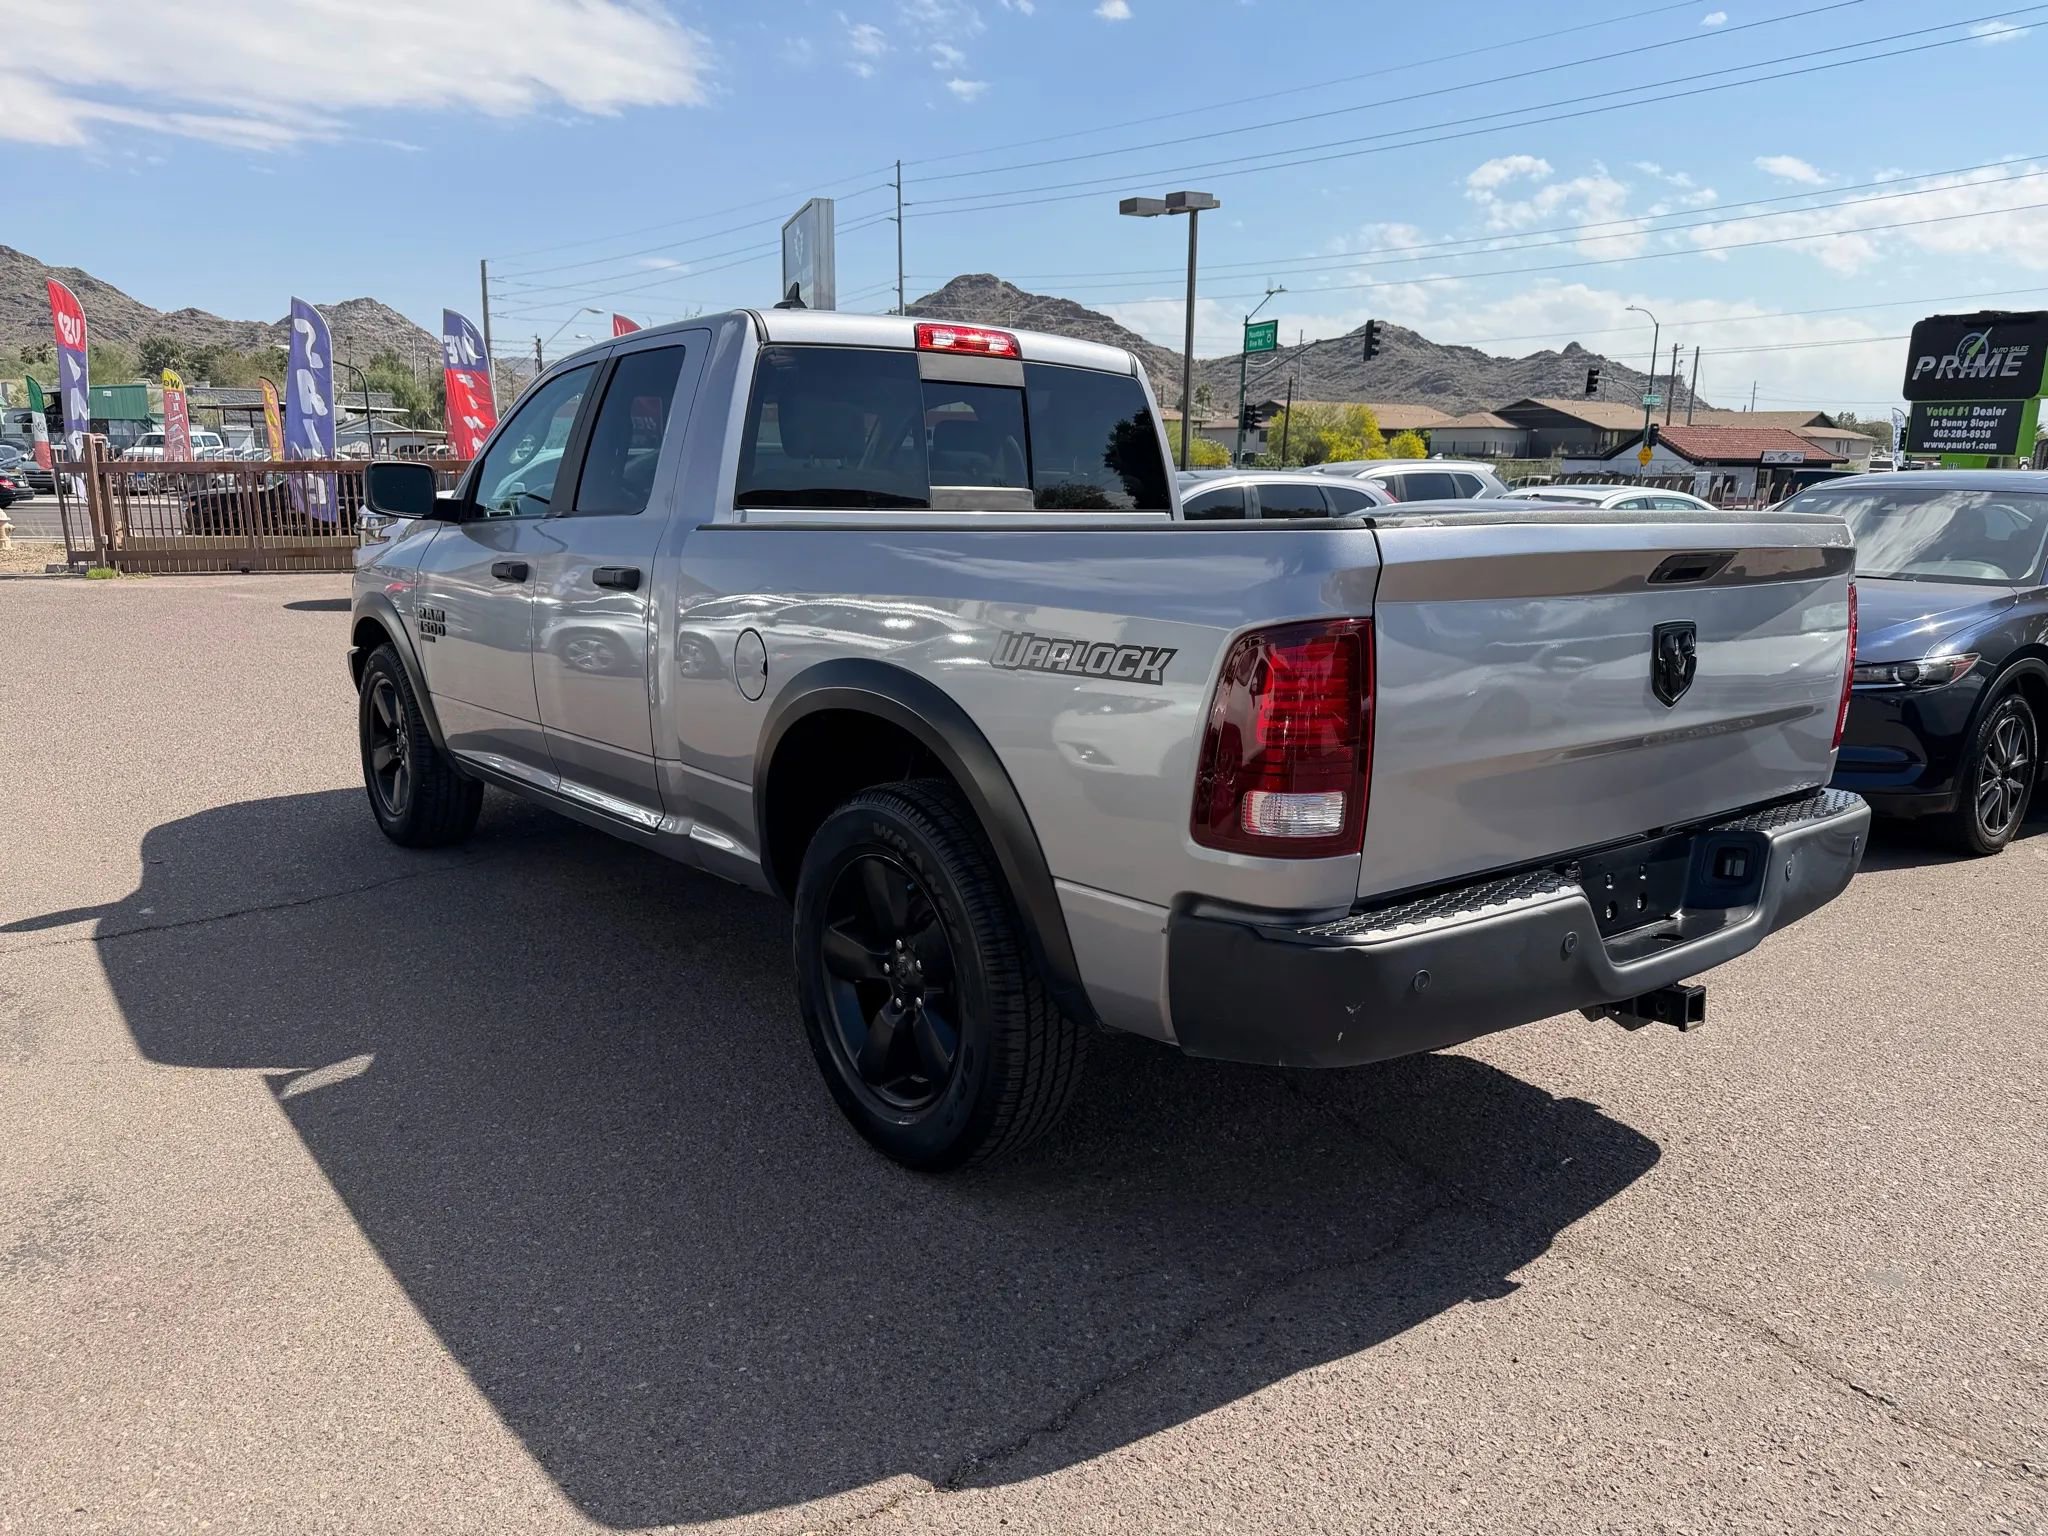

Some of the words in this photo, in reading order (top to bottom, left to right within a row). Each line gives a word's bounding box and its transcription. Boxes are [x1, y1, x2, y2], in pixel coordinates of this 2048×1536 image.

[2009, 345, 2029, 353] SALES
[1912, 352, 2028, 380] PRIME
[1926, 406, 1955, 416] Voted
[1957, 406, 1970, 416] #1
[1972, 406, 2007, 416] Dealer
[1930, 419, 1940, 427] In
[1941, 418, 1968, 429] Sunny
[1923, 441, 1997, 450] www.pauto1.com
[418, 607, 445, 622] RAM
[991, 630, 1179, 686] WARLOCK
